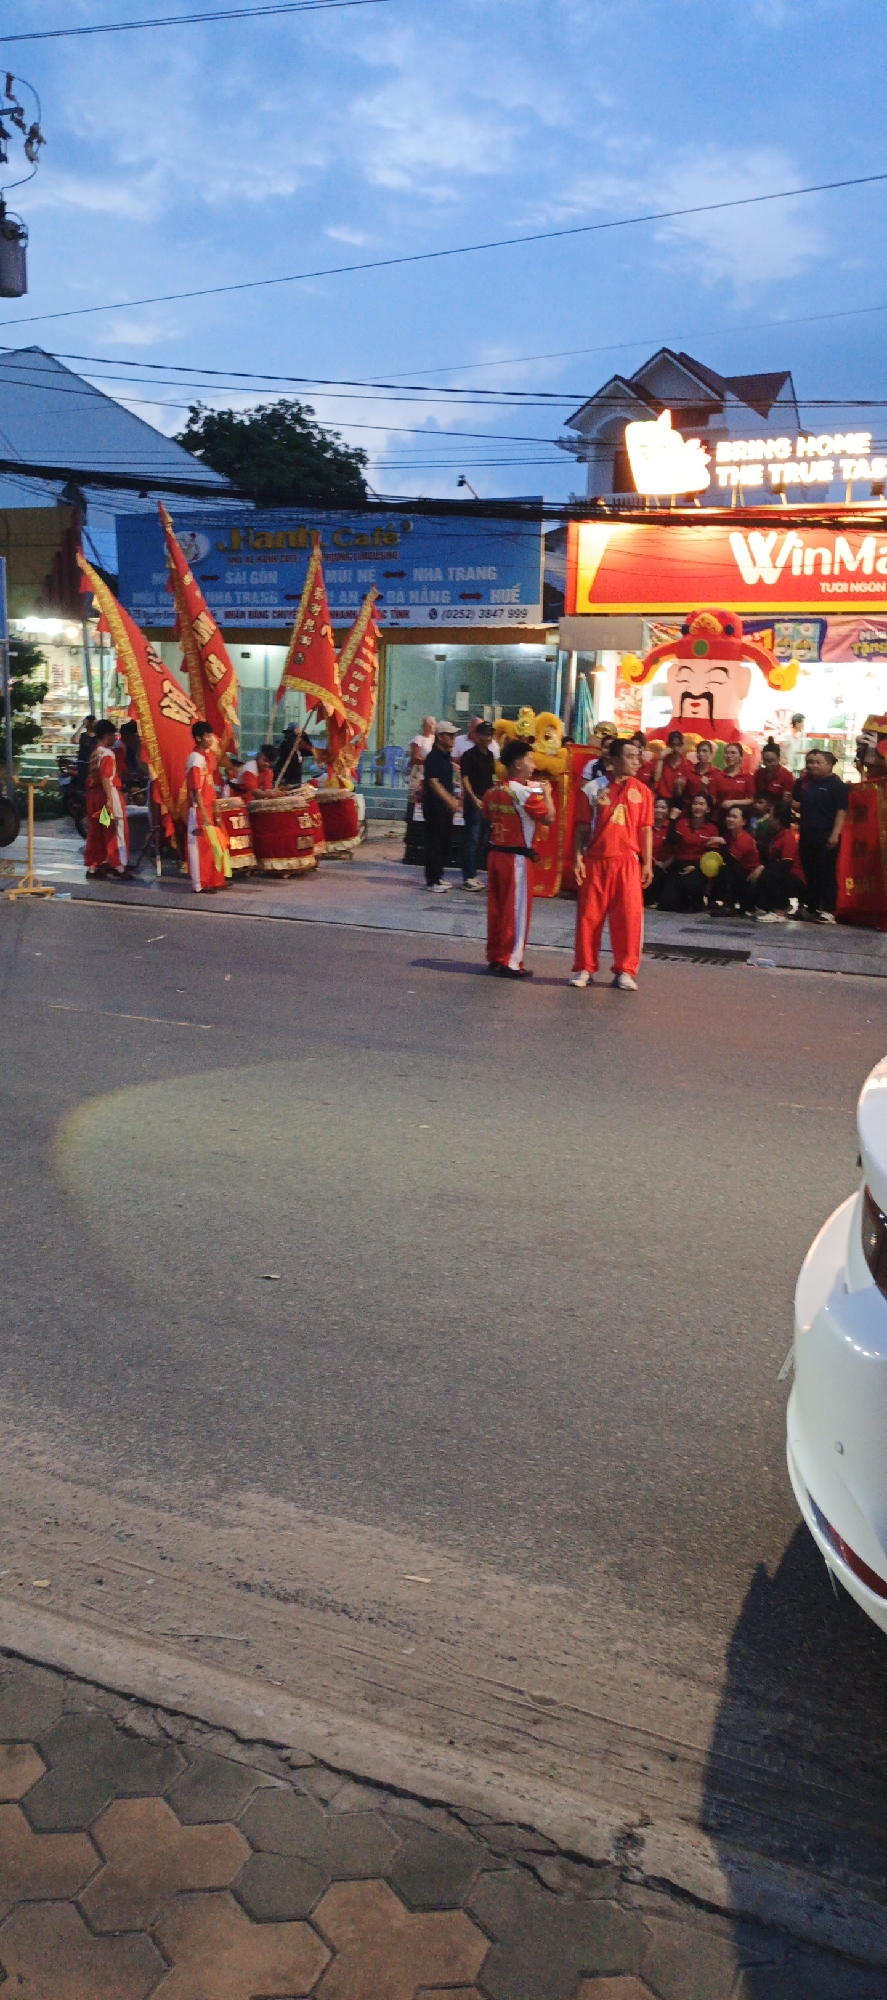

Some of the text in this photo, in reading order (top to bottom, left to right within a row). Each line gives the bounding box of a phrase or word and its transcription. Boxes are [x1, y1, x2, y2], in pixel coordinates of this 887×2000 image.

[715, 432, 873, 463] BRING HOME
[715, 464, 764, 487] THE
[767, 459, 835, 484] TRUE
[333, 522, 399, 547] Café
[413, 567, 443, 582] NHA
[448, 566, 498, 582] TRANG
[234, 591, 278, 604] TRANG
[490, 582, 521, 604] HUẾ
[441, 608, 476, 620] (0252)
[478, 608, 504, 618] 3847
[507, 608, 529, 619] 999
